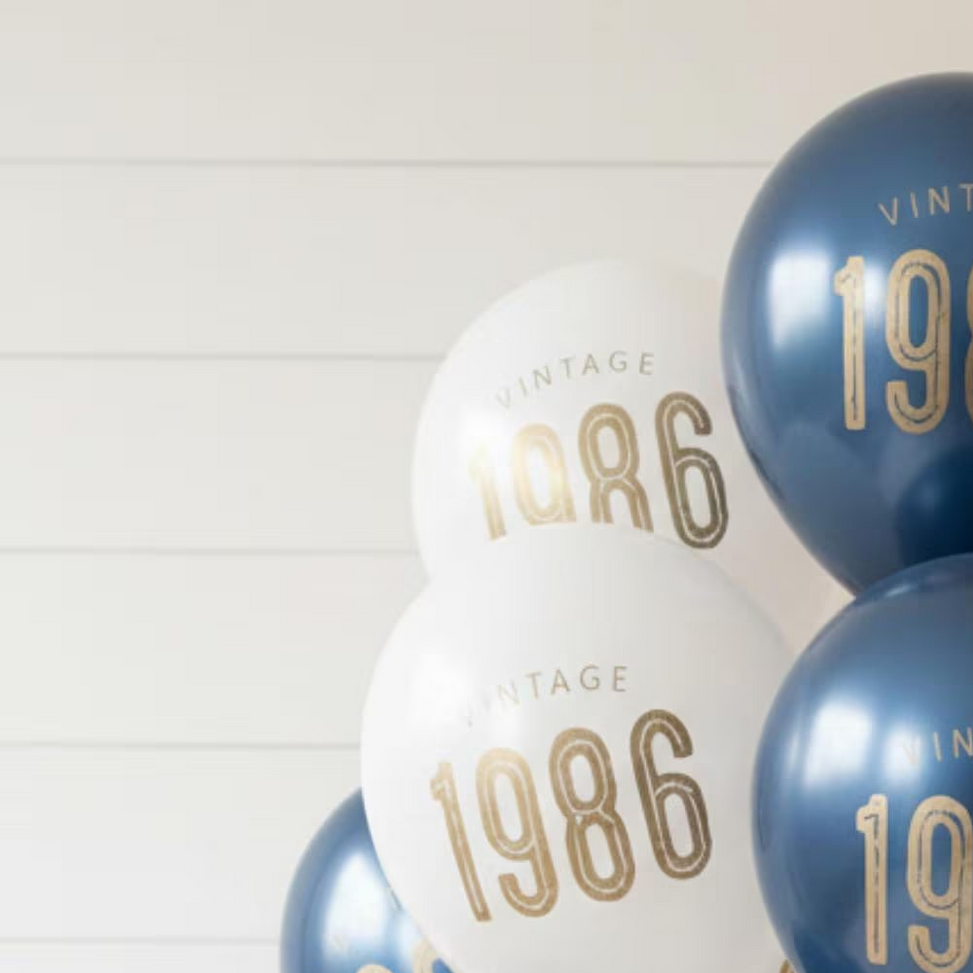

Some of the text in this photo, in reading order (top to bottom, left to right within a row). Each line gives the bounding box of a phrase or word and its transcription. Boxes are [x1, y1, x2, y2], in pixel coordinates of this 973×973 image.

[496, 350, 655, 409] VINTAGE
[463, 664, 628, 728] NTAGE
[430, 709, 713, 922] 1986
